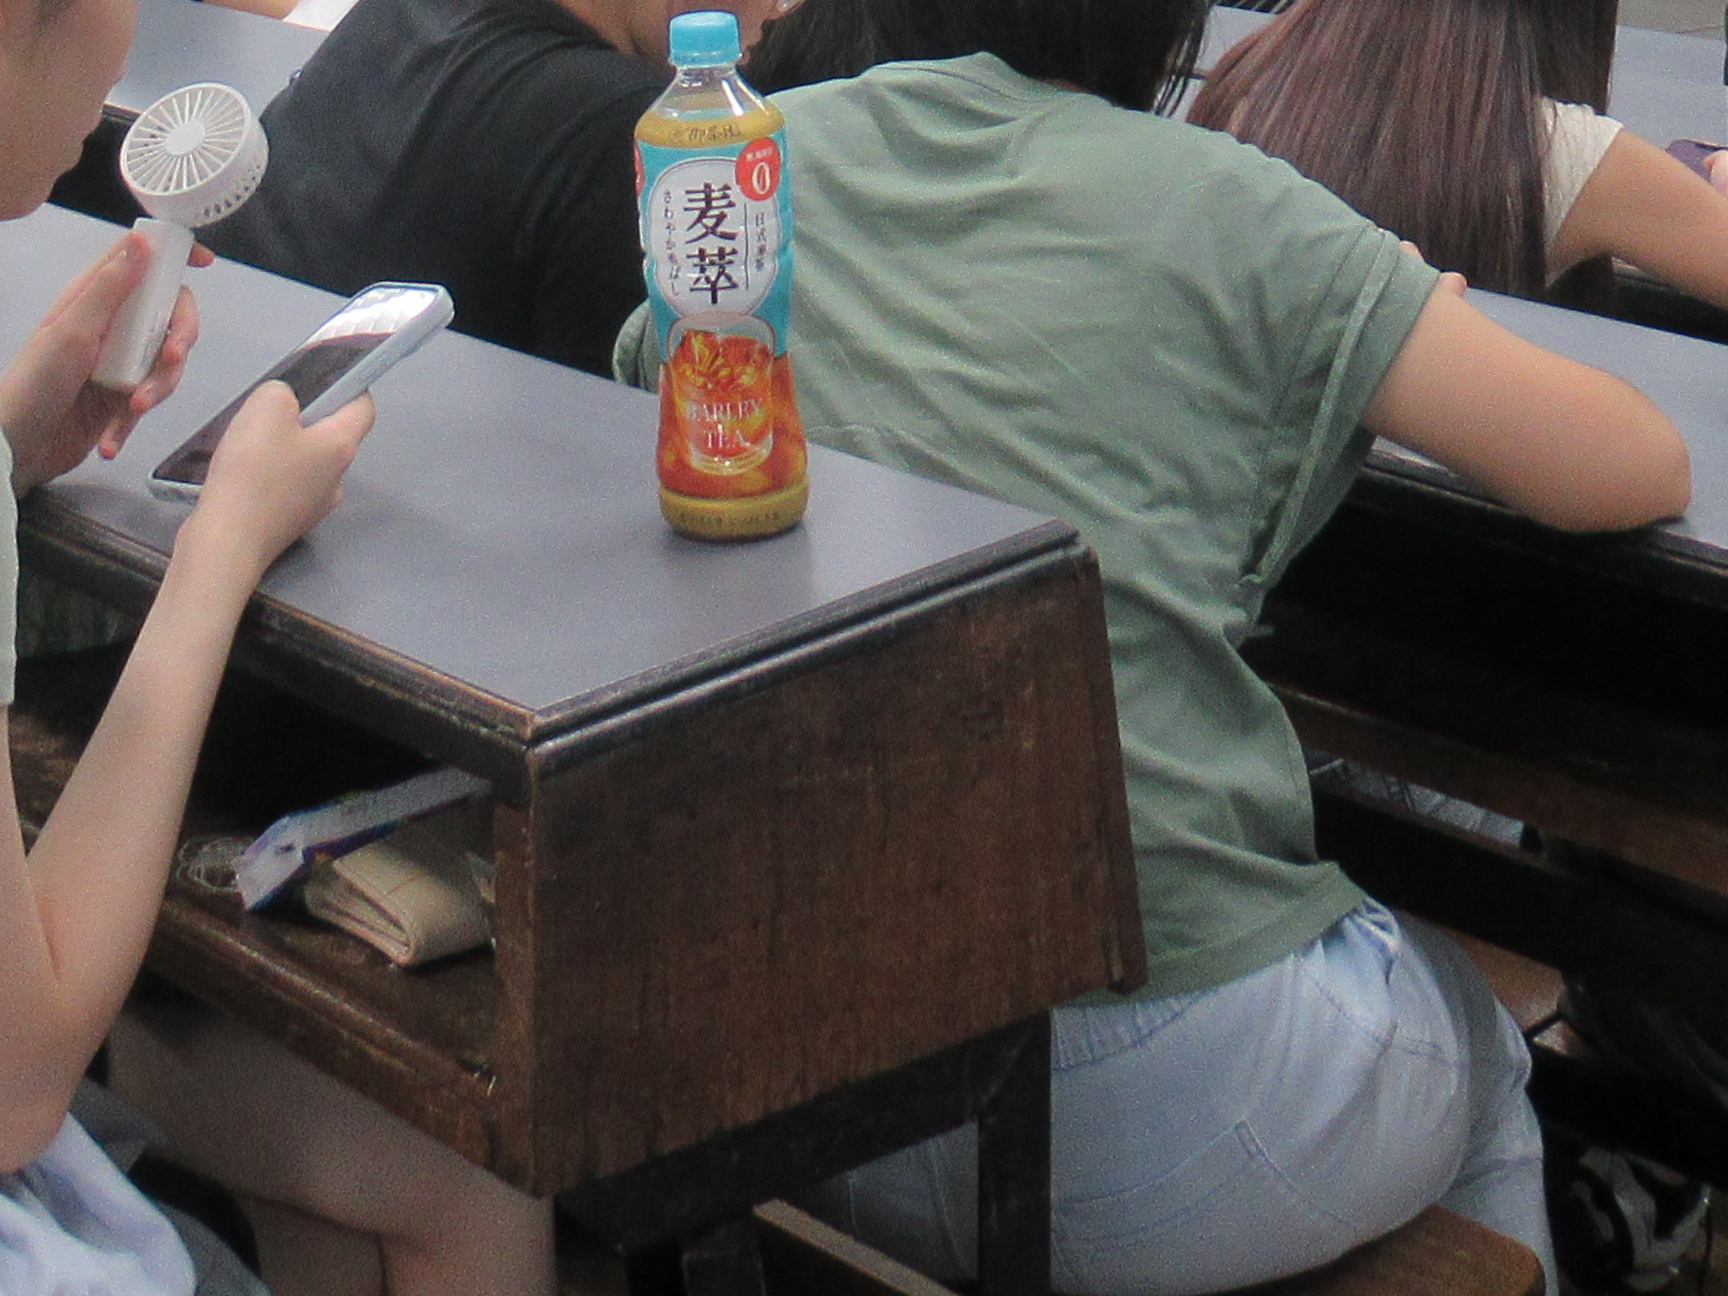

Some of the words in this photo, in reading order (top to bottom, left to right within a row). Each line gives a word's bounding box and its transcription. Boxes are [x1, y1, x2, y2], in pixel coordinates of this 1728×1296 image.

[752, 162, 771, 194] 0
[684, 399, 765, 421] BARLEY
[703, 429, 748, 448] TEA
